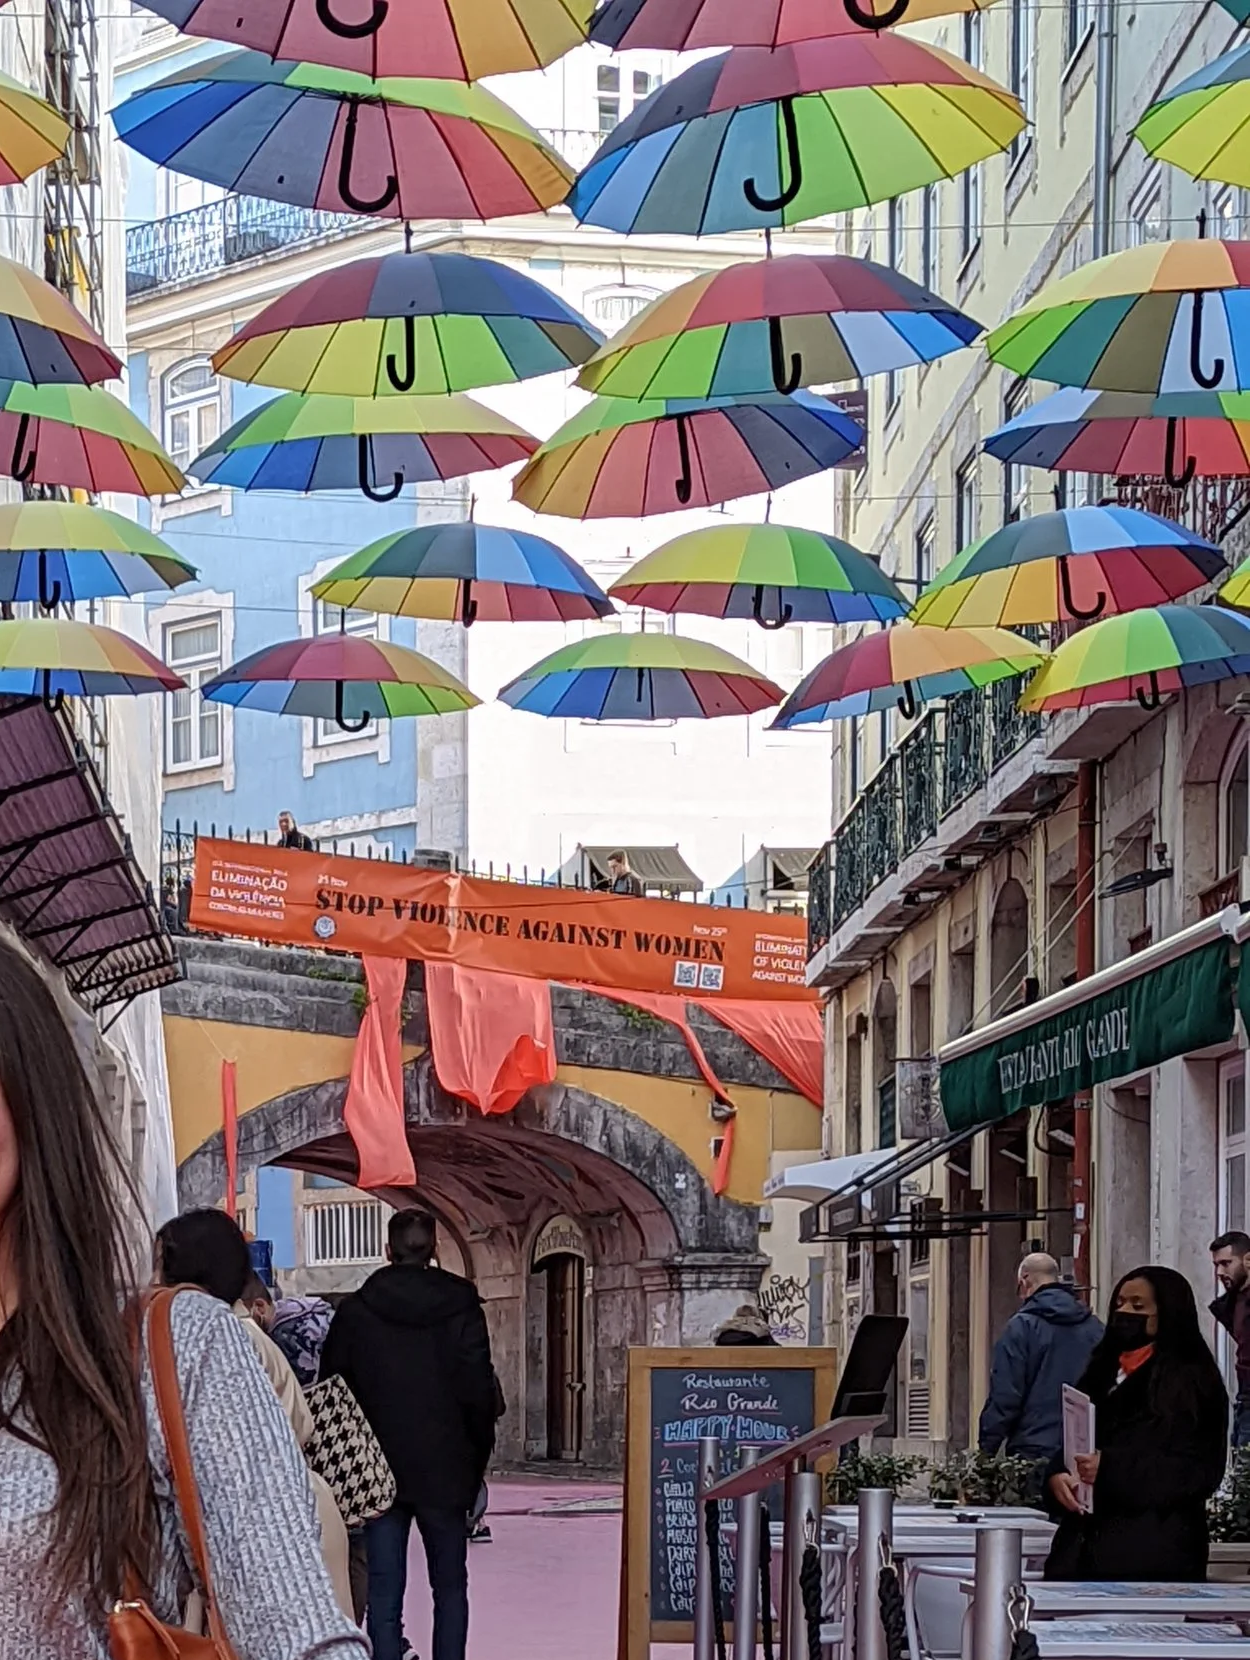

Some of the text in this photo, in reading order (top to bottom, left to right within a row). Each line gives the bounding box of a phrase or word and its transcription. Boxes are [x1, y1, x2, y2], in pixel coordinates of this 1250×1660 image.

[212, 869, 288, 892] ELIMINAÇÃO
[210, 887, 226, 899] DA
[316, 888, 726, 962] STOP VIOLENCE AGAINST WOMEN
[753, 955, 769, 967] OF
[682, 1373, 771, 1389] Restaurante
[680, 1392, 779, 1412] Rio Grande
